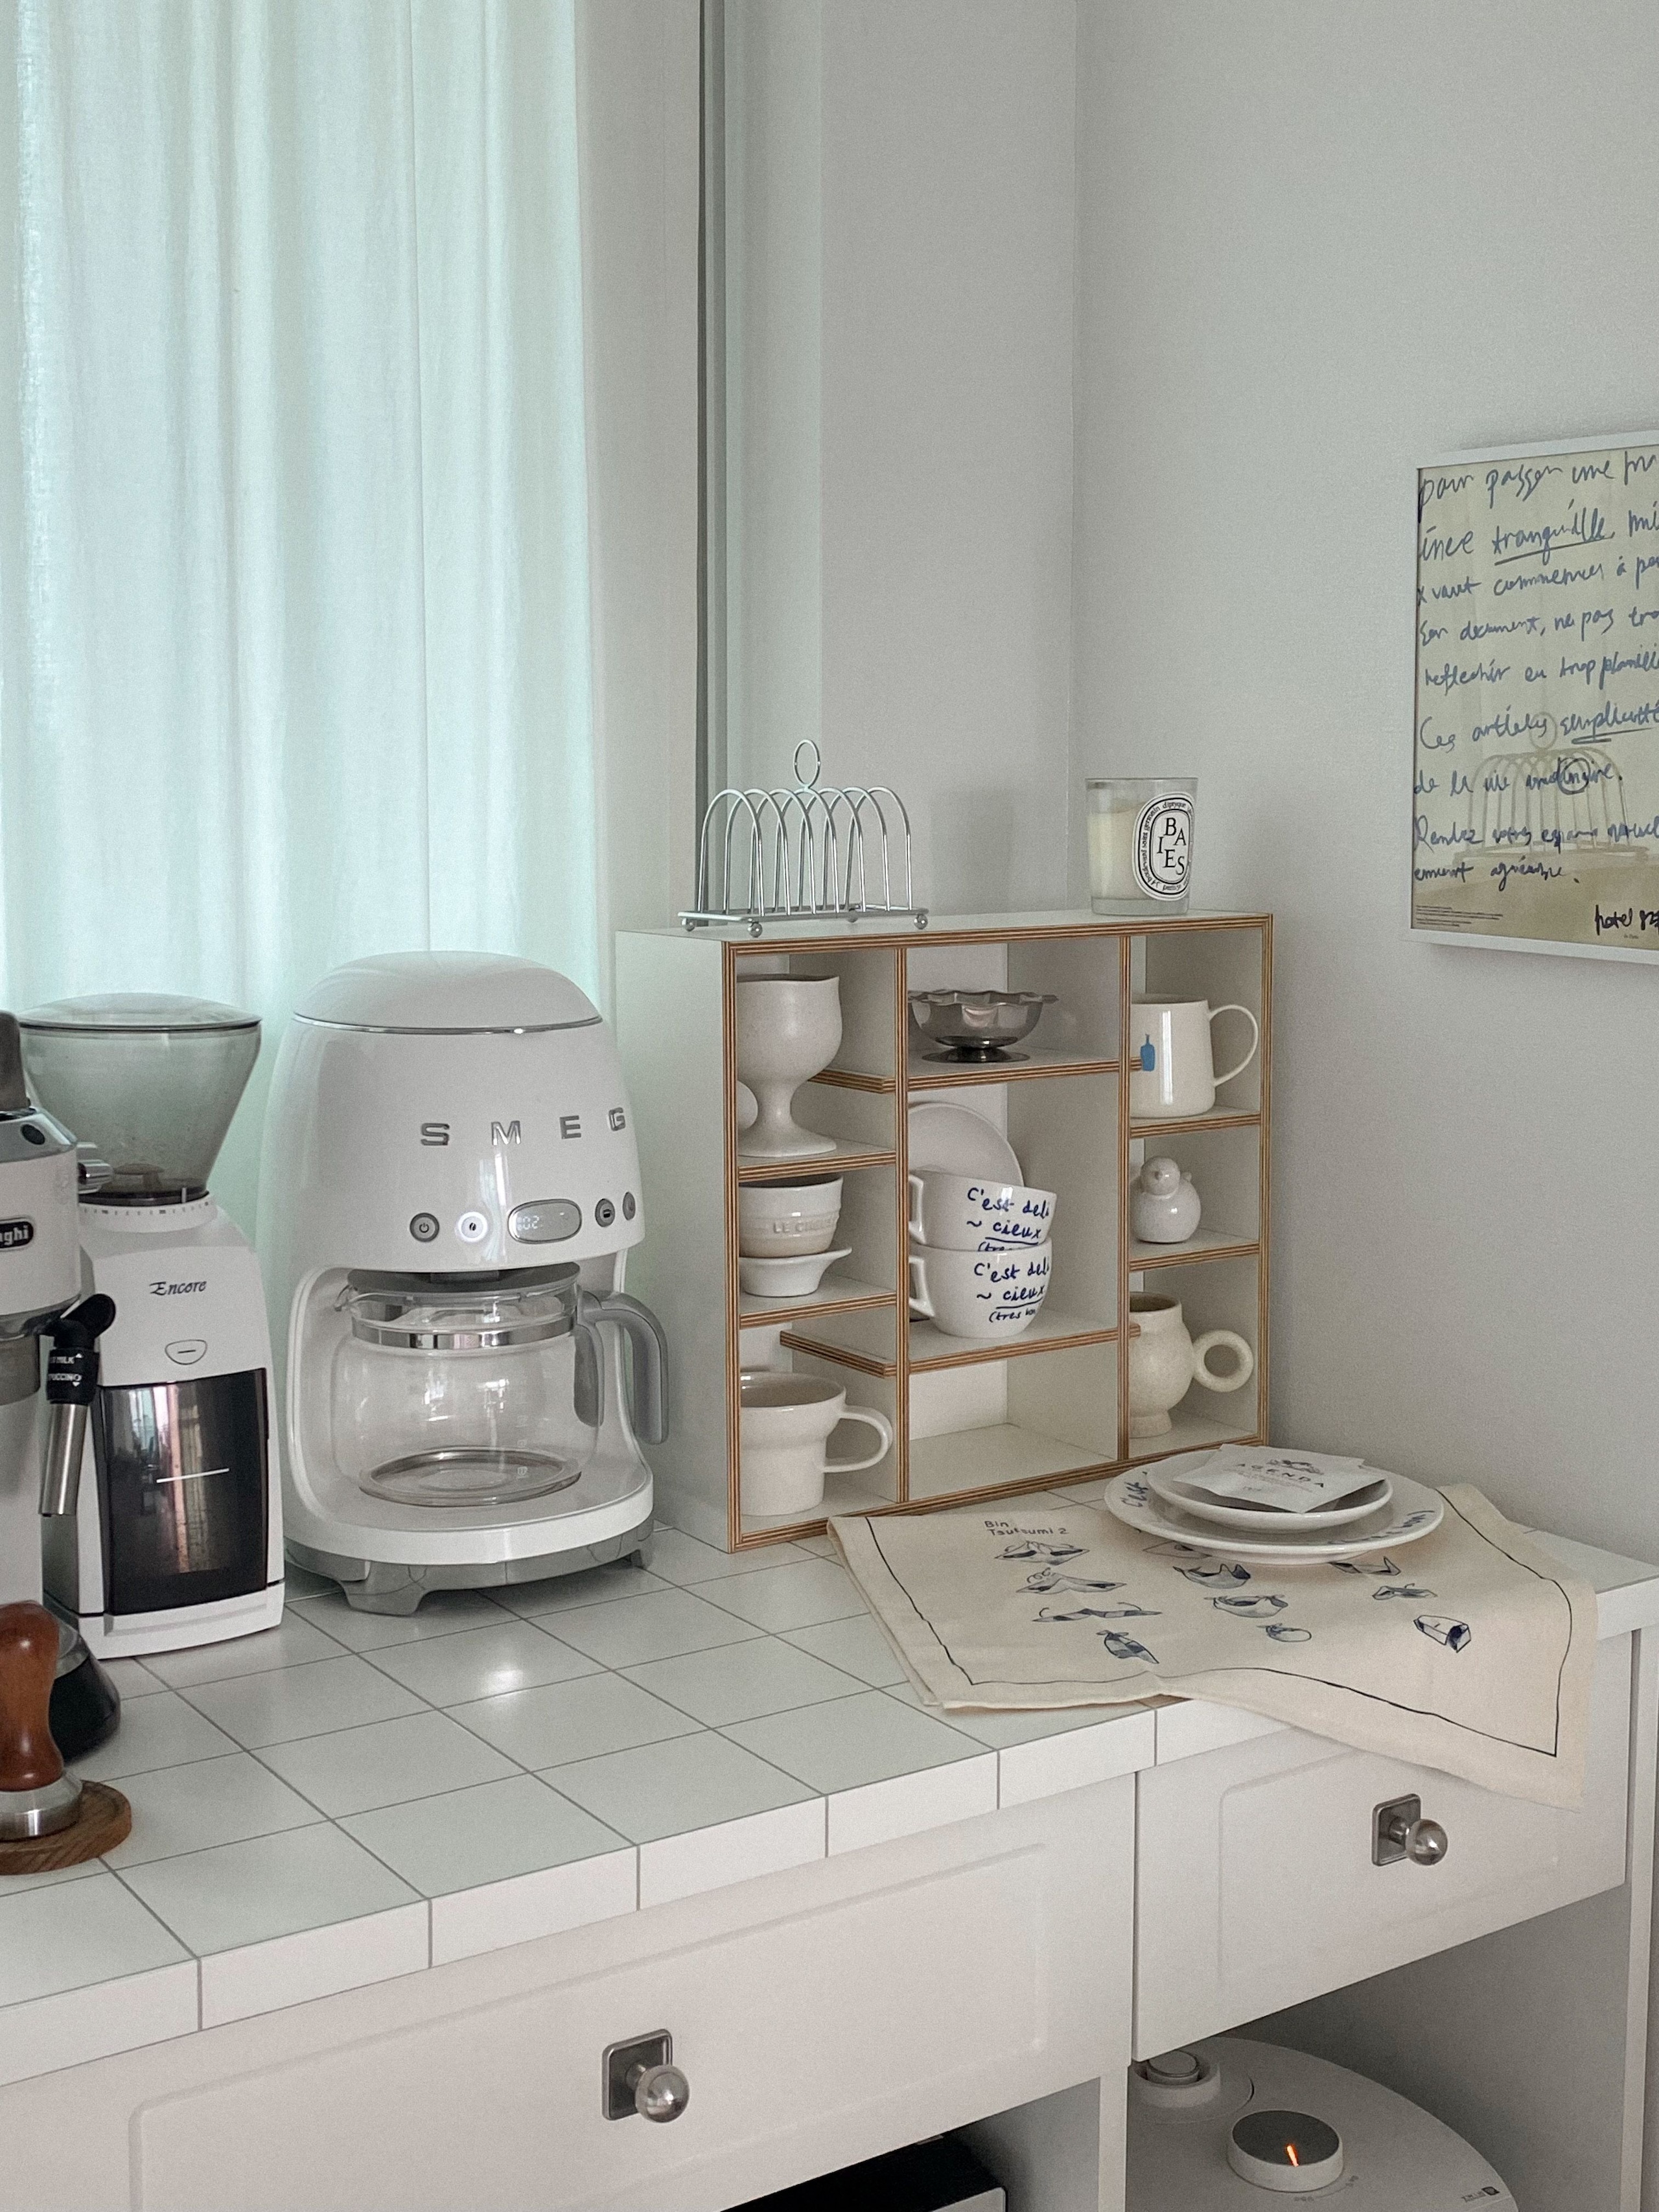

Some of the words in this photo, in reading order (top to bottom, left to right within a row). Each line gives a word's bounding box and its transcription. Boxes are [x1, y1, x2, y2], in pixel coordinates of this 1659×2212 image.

[421, 1107, 626, 1146] SMEG
[968, 1188, 1014, 1211] C'est
[993, 1220, 1041, 1239] cieux
[974, 1263, 1020, 1282] C'est
[149, 1281, 207, 1296] Encore
[1003, 1285, 1045, 1301] cieux
